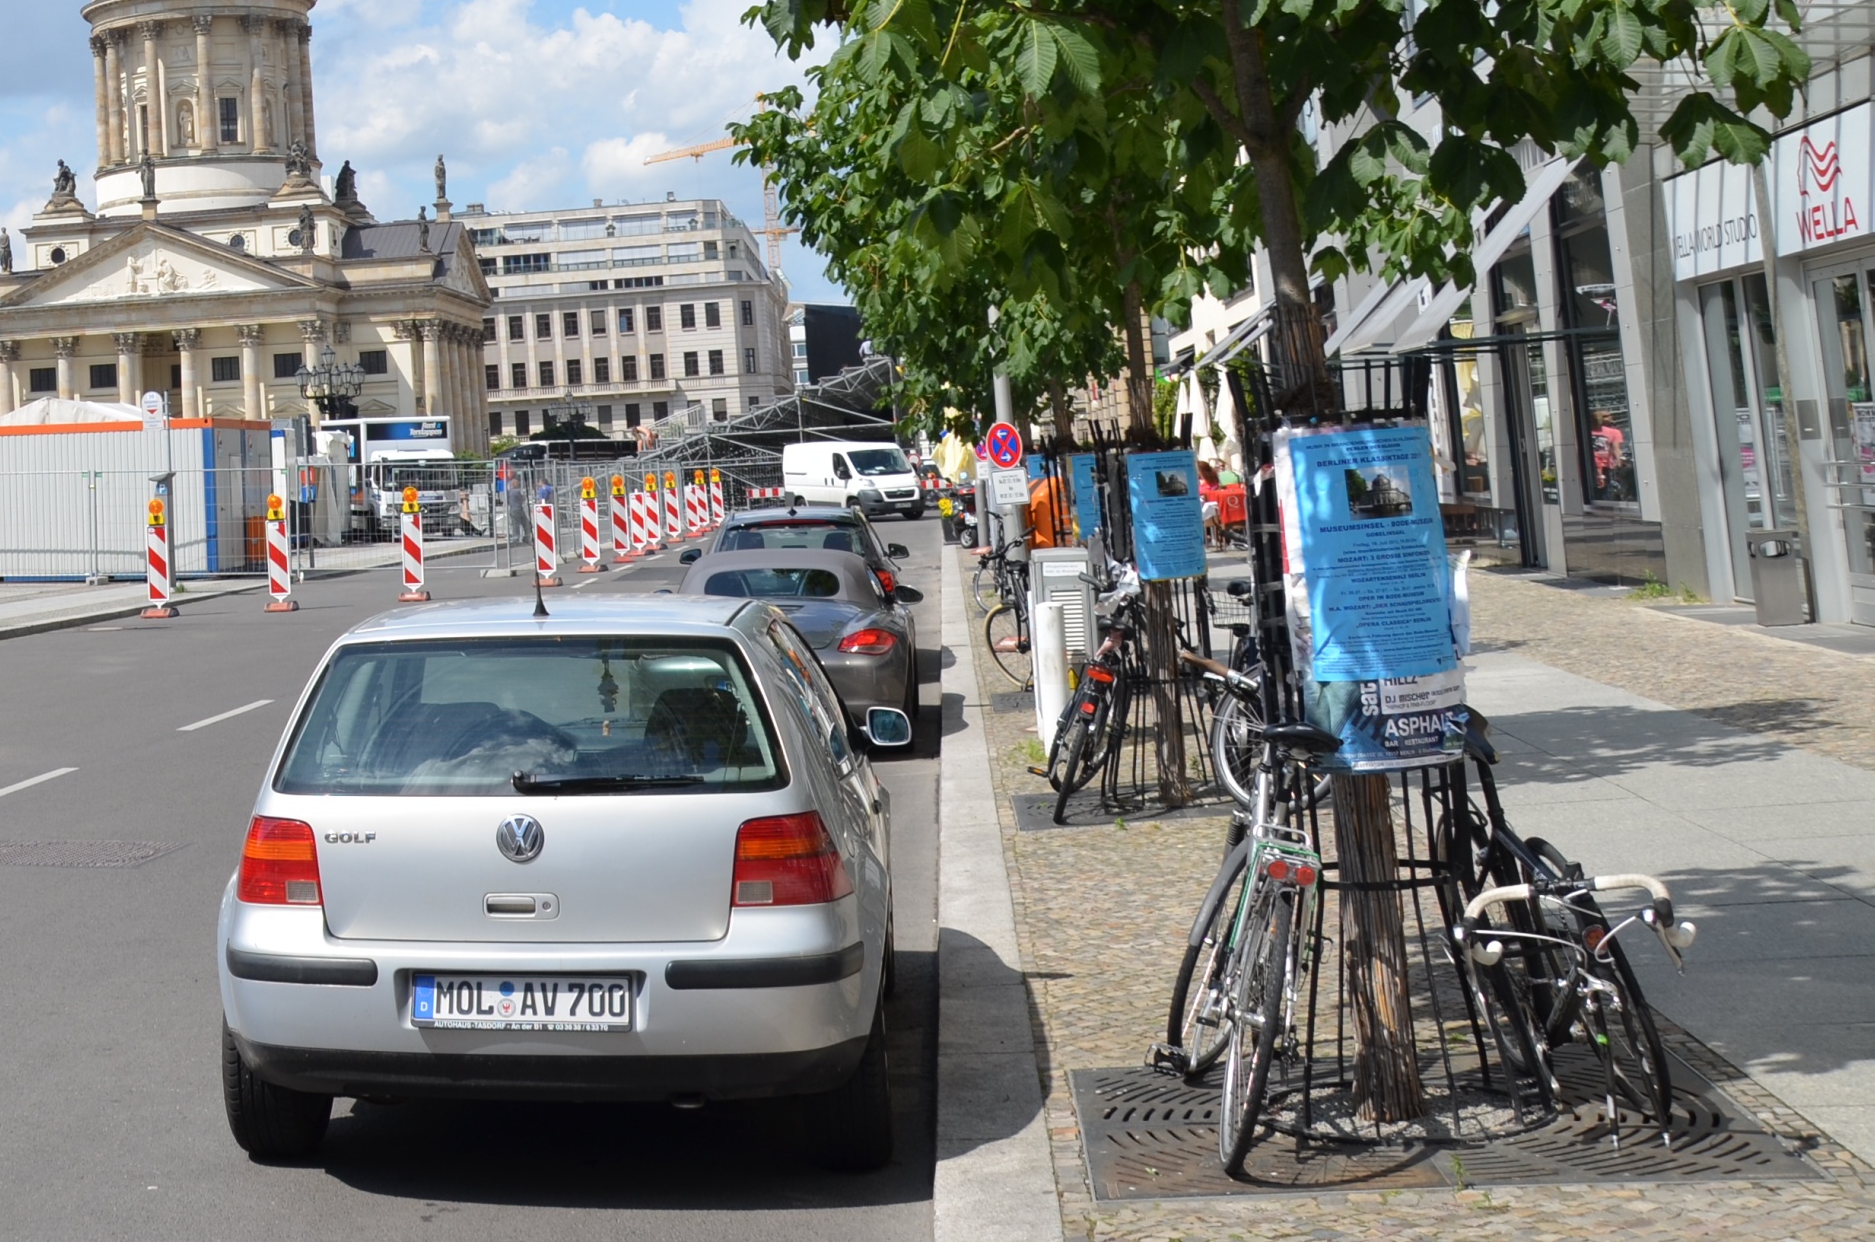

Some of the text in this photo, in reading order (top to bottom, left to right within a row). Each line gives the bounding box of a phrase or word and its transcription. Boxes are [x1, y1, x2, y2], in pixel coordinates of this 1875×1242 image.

[1796, 196, 1859, 245] WELLA
[1696, 223, 1723, 254] WORLD
[1724, 213, 1758, 246] STUDIO
[1317, 456, 1358, 468] BERLINER
[1319, 520, 1385, 533] MUSEUMSINSEL
[1385, 694, 1397, 704] DJ
[1384, 739, 1399, 747] BAR
[1404, 735, 1439, 746] RESTAURANT
[324, 830, 377, 844] GOLF
[420, 981, 625, 1017] D MOL AV 700
[511, 1022, 523, 1030] An
[524, 1022, 532, 1030] der
